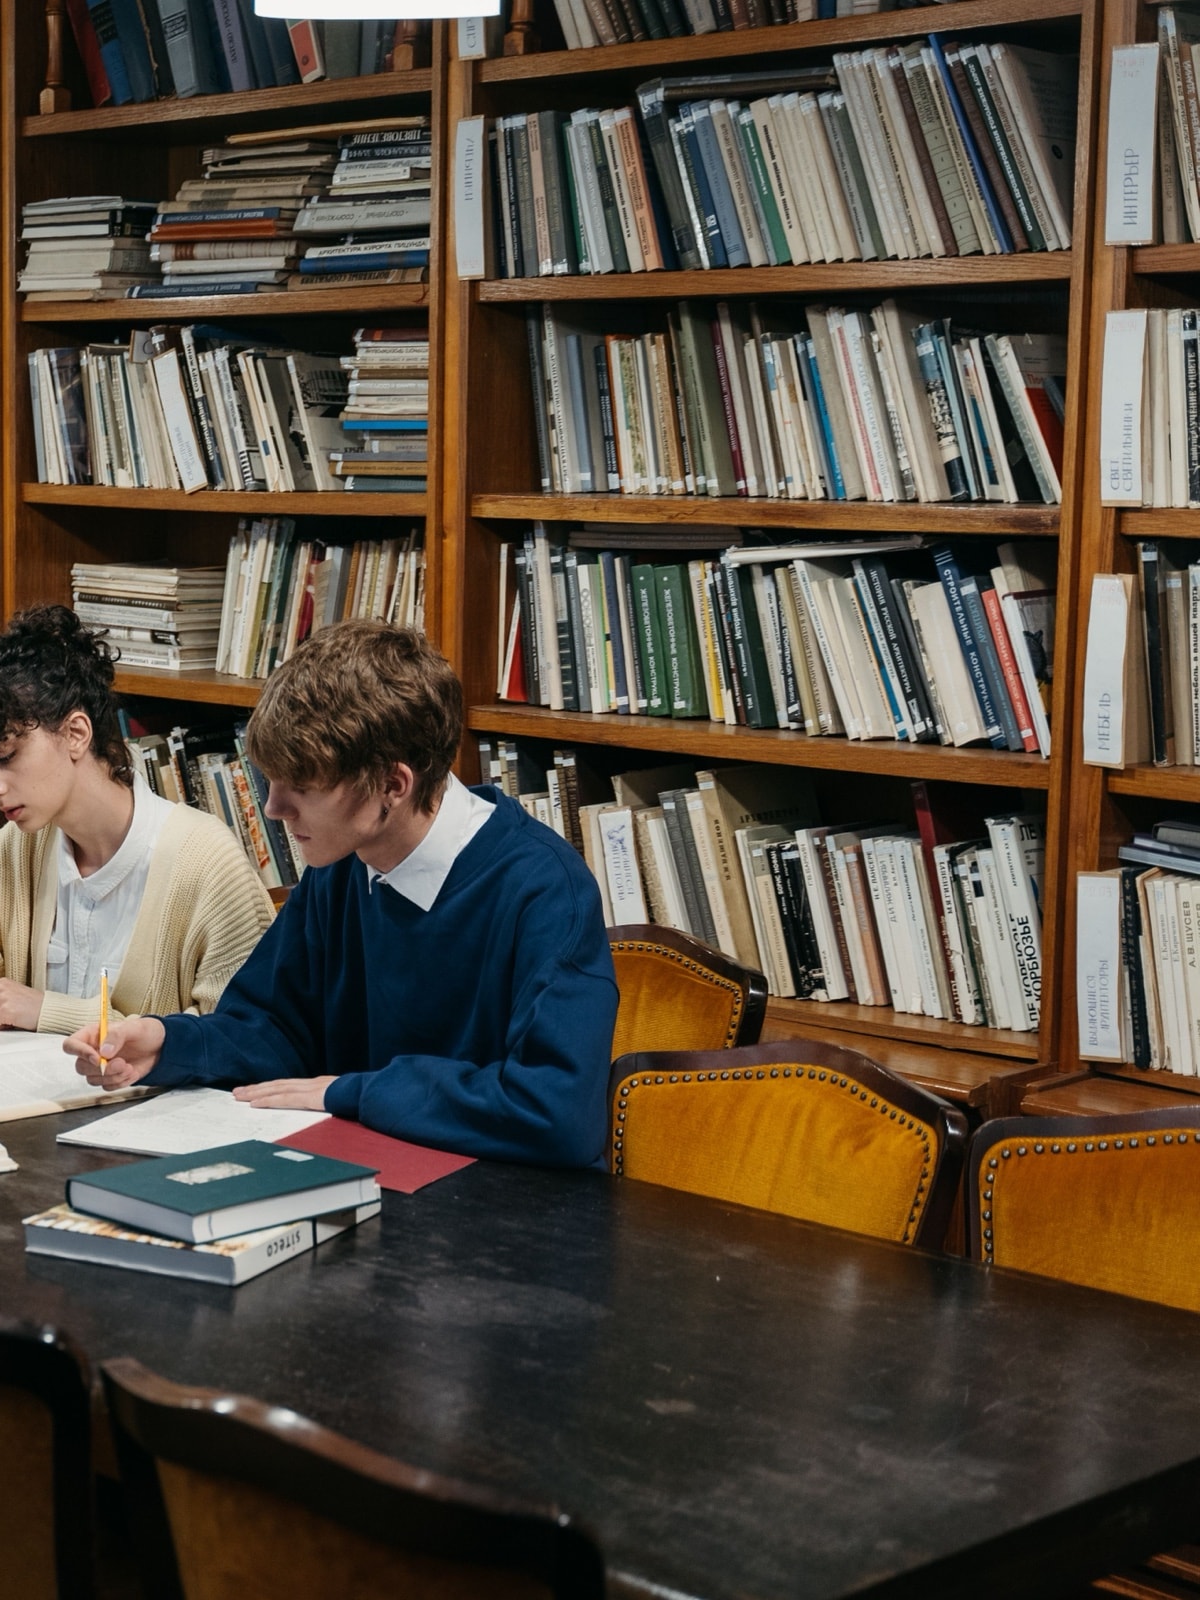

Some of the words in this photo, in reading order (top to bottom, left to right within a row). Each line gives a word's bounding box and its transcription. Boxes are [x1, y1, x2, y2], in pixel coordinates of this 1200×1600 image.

[968, 62, 982, 86] ДОРОГ
[1181, 60, 1196, 94] ЗДАНИЙ
[978, 86, 1000, 129] ГОРОДСКИХ
[994, 130, 1022, 198] ПРОЕКТИРОВАНИЯ
[1009, 133, 1036, 195] ПРОЕКТИРОВАНИЕ
[1121, 149, 1140, 225] ИНТЕРЬЕР
[1016, 199, 1033, 231] ОСНОВЫ
[319, 245, 361, 256] АРХИТЕКТУРА
[364, 242, 392, 253] КУРОРТА
[394, 239, 426, 250] ПИЦУНДА
[641, 588, 654, 654] ЖЕЛЕЗОБЕТОННЫЕ
[663, 588, 677, 655] ЖЕЛЕЗОБЕТОННЫЕ
[731, 608, 743, 640] История
[869, 569, 886, 605] ИСТОРИЯ
[881, 607, 897, 640] РУССКОЙ
[892, 642, 912, 693] АРХИТЕКТУРЫ
[943, 568, 974, 646] СТРОИТЕЛЬНЫЕ
[969, 651, 997, 723] КОНСТРУКЦИИ
[746, 697, 754, 710] Том
[1097, 692, 1111, 752] МЕБЕЛЬ
[1006, 851, 1019, 888] АРХИТЕКТУРА
[1182, 890, 1195, 933] ЩУСЕВ
[1187, 934, 1195, 945] В.
[1189, 947, 1197, 958] А.
